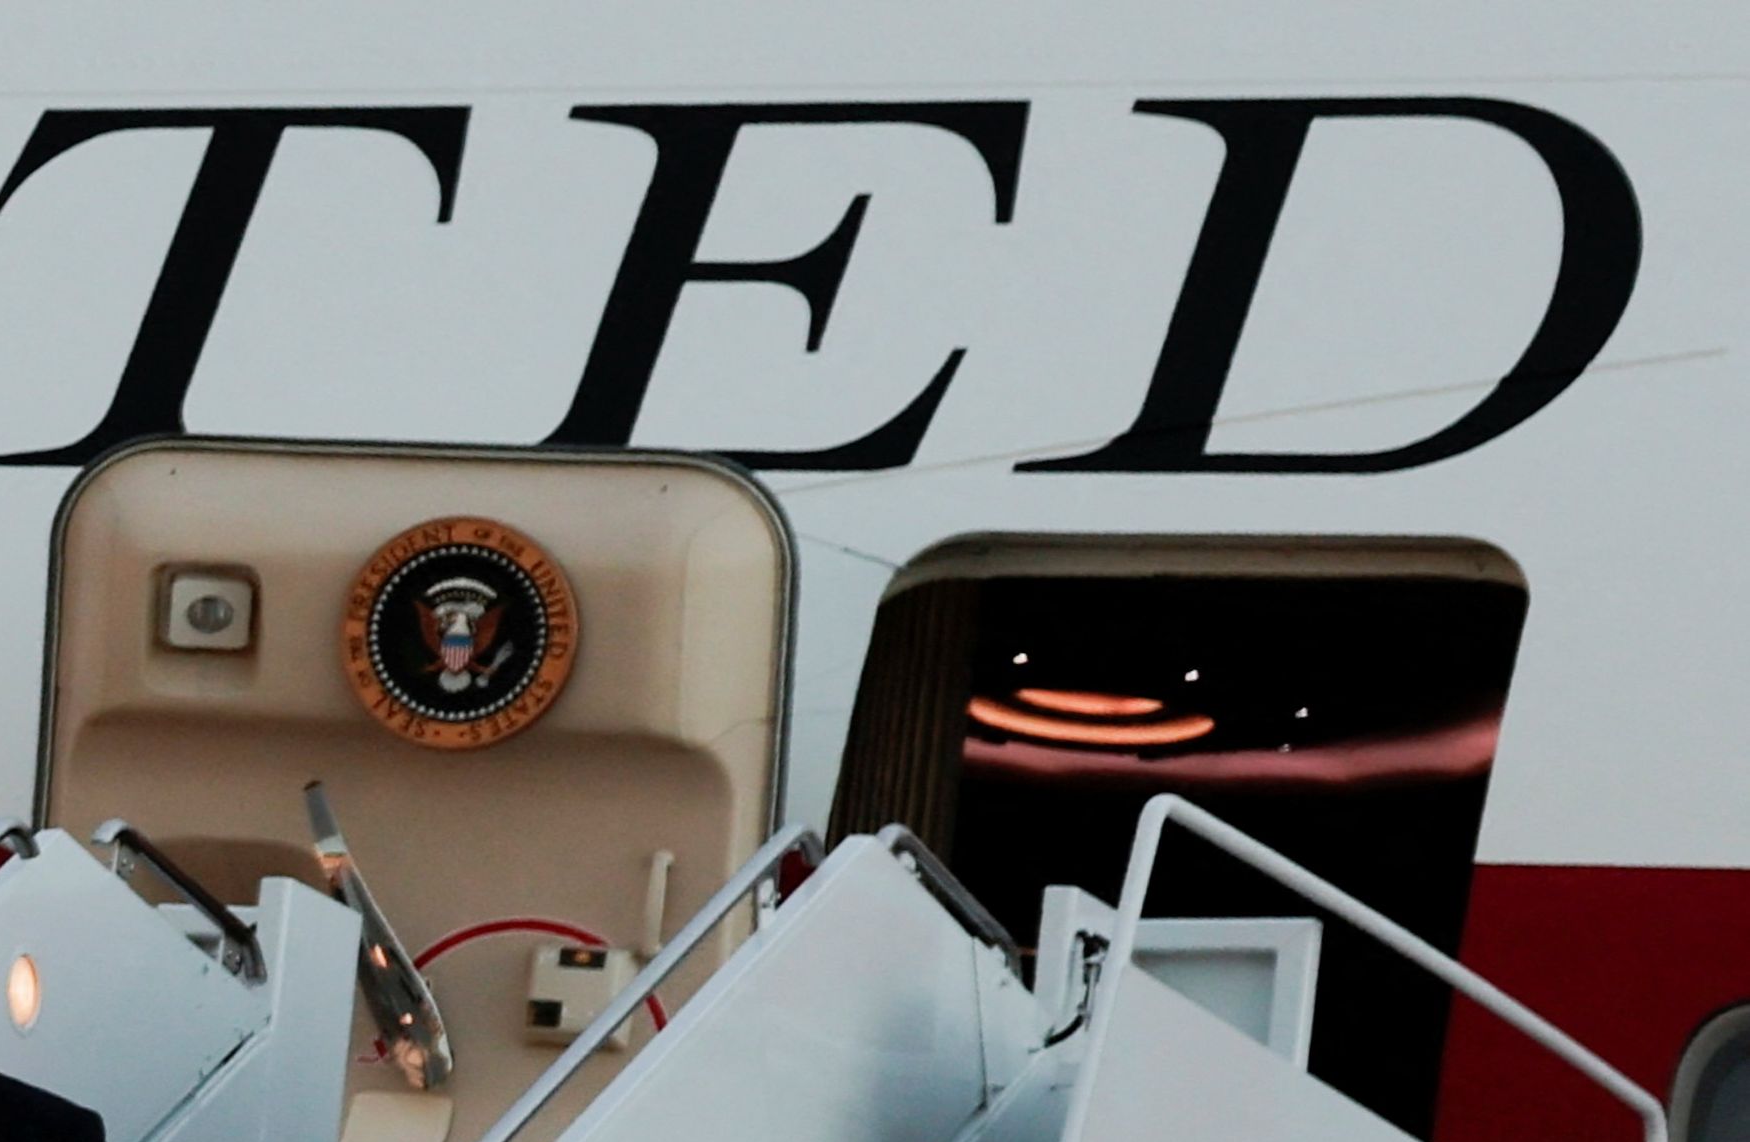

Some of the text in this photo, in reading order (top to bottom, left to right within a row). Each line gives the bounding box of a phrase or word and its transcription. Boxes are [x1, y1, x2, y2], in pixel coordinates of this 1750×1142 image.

[350, 525, 456, 618] PRESIDENT
[530, 560, 569, 659] UNITED
[372, 694, 426, 739] SEAL
[469, 680, 552, 741] STATES
